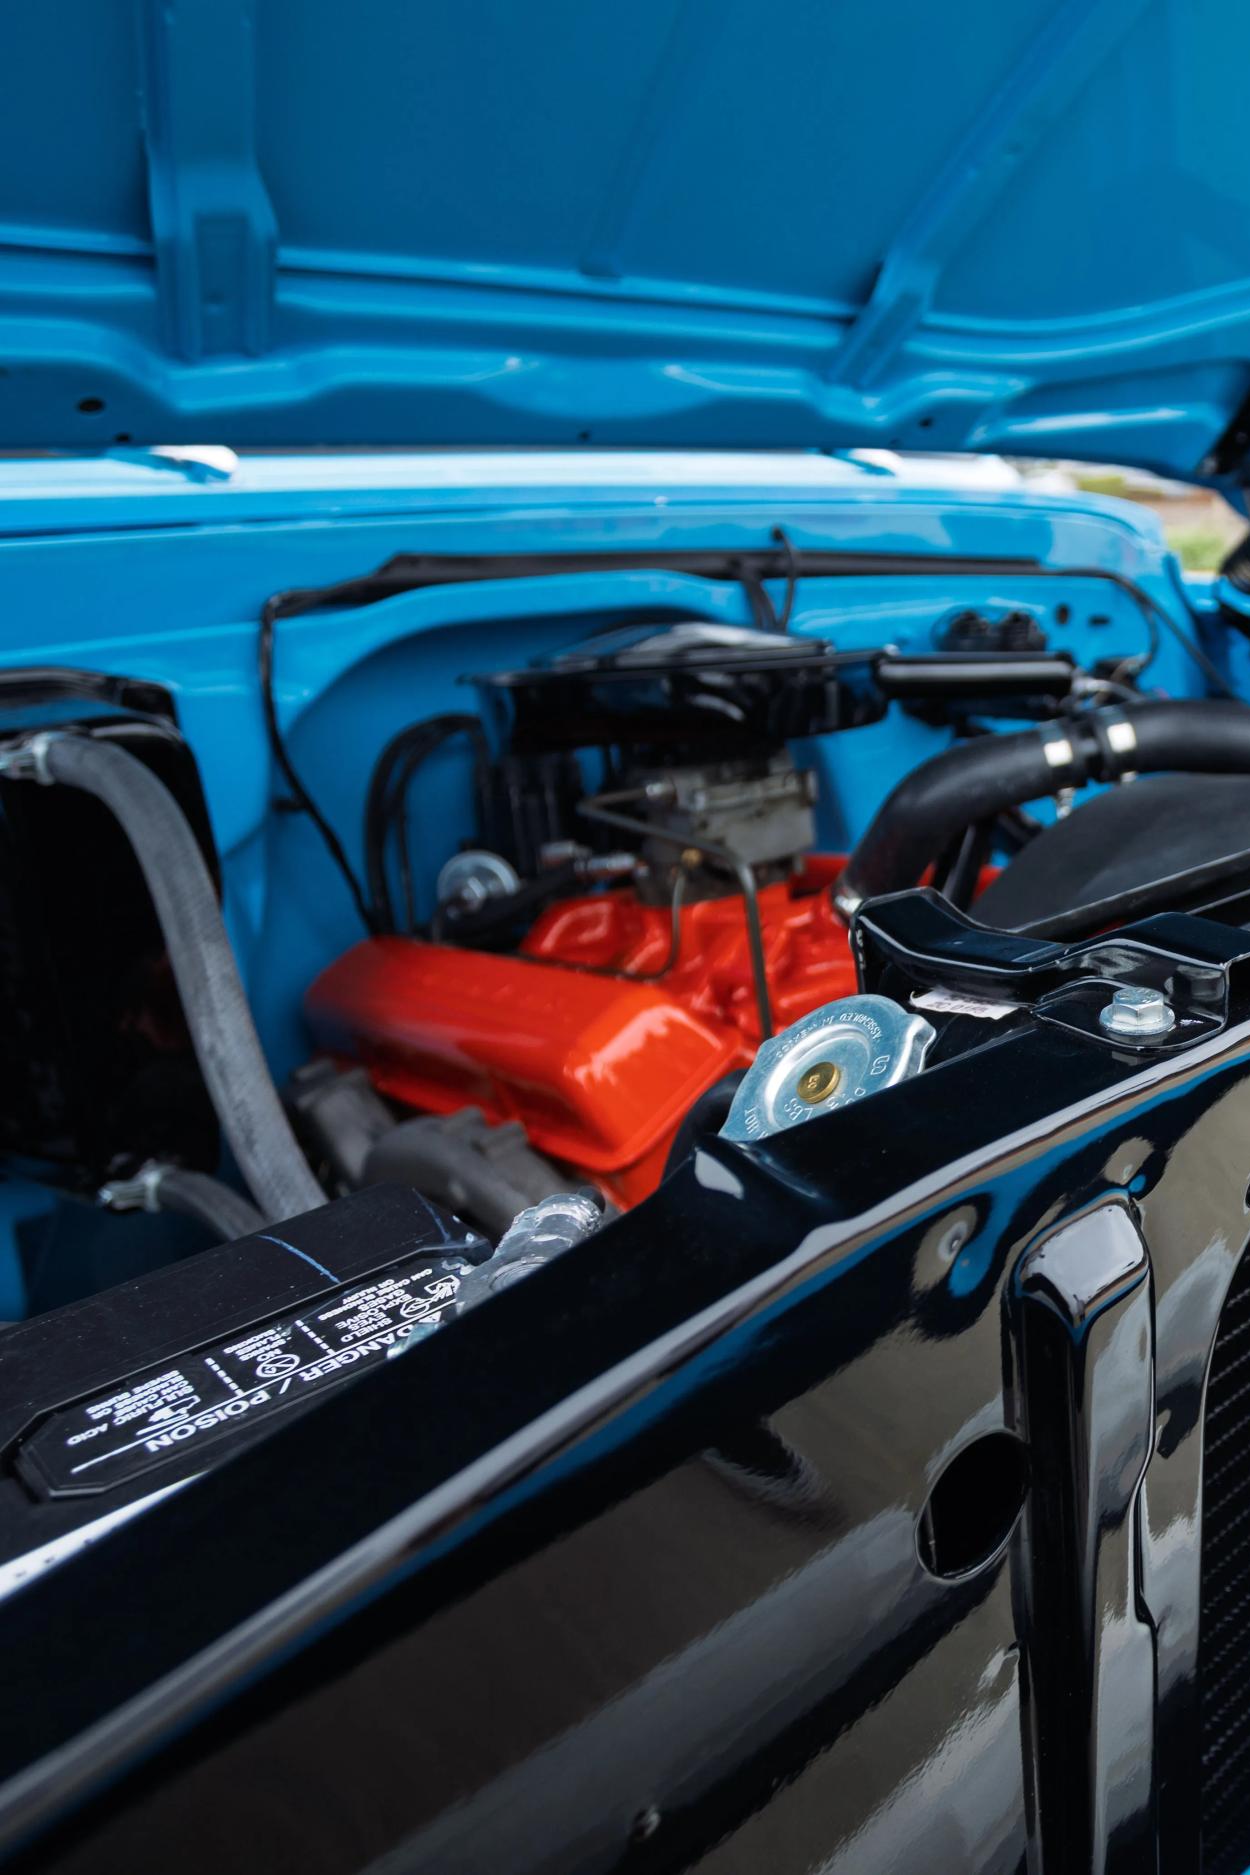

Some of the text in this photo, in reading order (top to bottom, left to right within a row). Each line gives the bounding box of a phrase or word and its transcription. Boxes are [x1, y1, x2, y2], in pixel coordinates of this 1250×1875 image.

[410, 1269, 432, 1281] CAN
[358, 1289, 405, 1311] GASES
[335, 1294, 412, 1329] EXPLOSIVE
[348, 1312, 387, 1331] EYES
[341, 1318, 392, 1342] SHIELD
[235, 1334, 281, 1356] FLAMES
[256, 1348, 282, 1361] NO
[298, 1325, 414, 1381] DANGER
[160, 1380, 188, 1395] CAN
[66, 1385, 194, 1446] SULFURIC ACID
[144, 1390, 271, 1452] POISON
